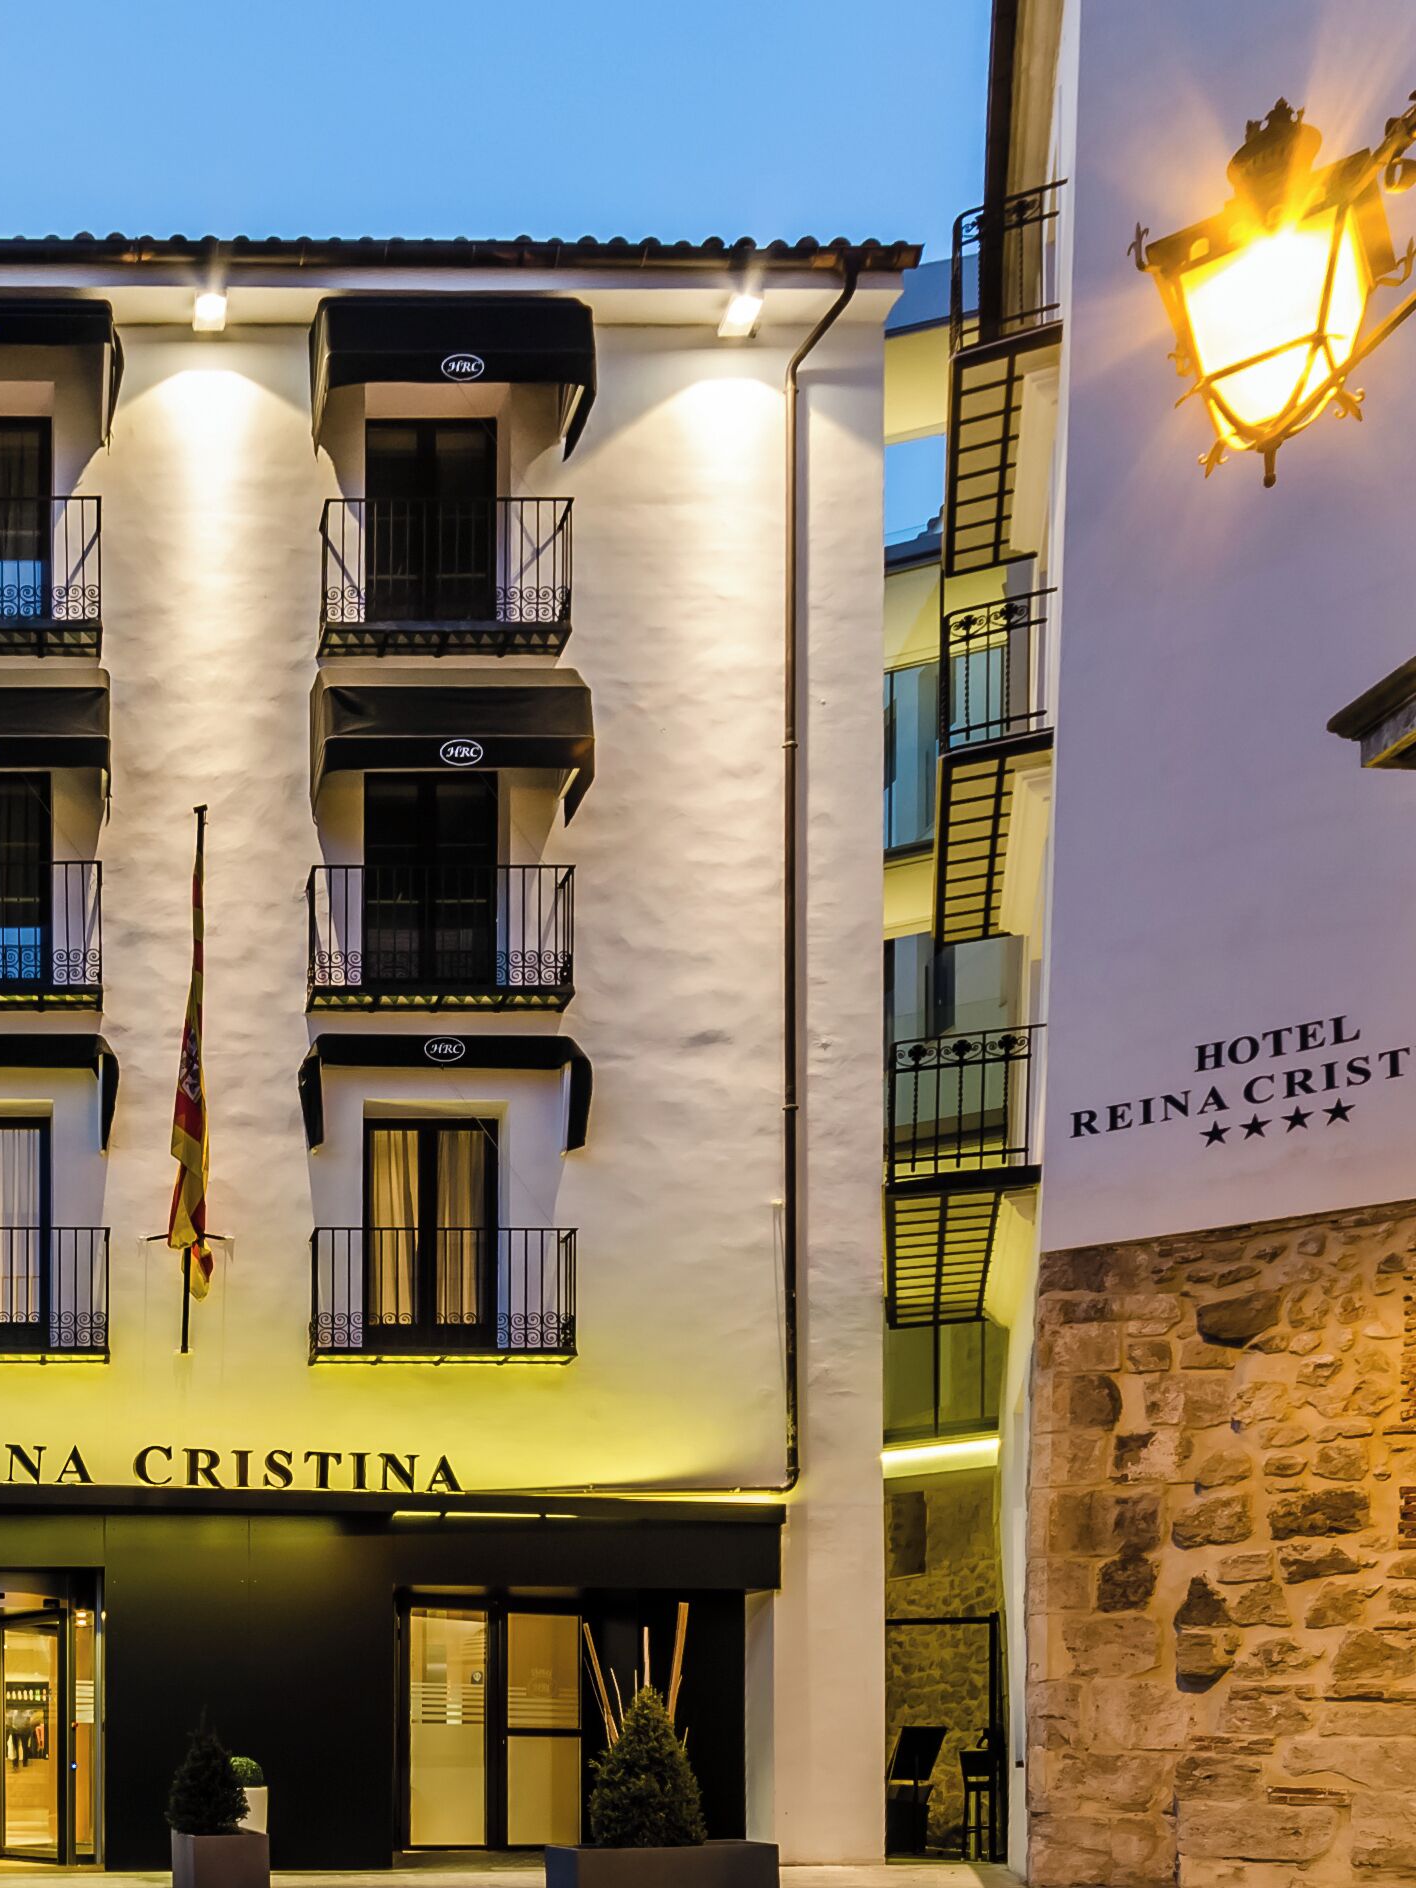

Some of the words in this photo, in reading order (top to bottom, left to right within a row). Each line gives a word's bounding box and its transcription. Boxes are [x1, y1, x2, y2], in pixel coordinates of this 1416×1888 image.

[447, 360, 480, 372] HRC
[445, 745, 479, 758] HRC
[429, 1042, 462, 1054] HRC
[1195, 1015, 1361, 1073] HOTEL
[1070, 1085, 1230, 1139] REINA
[133, 1445, 465, 1493] CRISTINA
